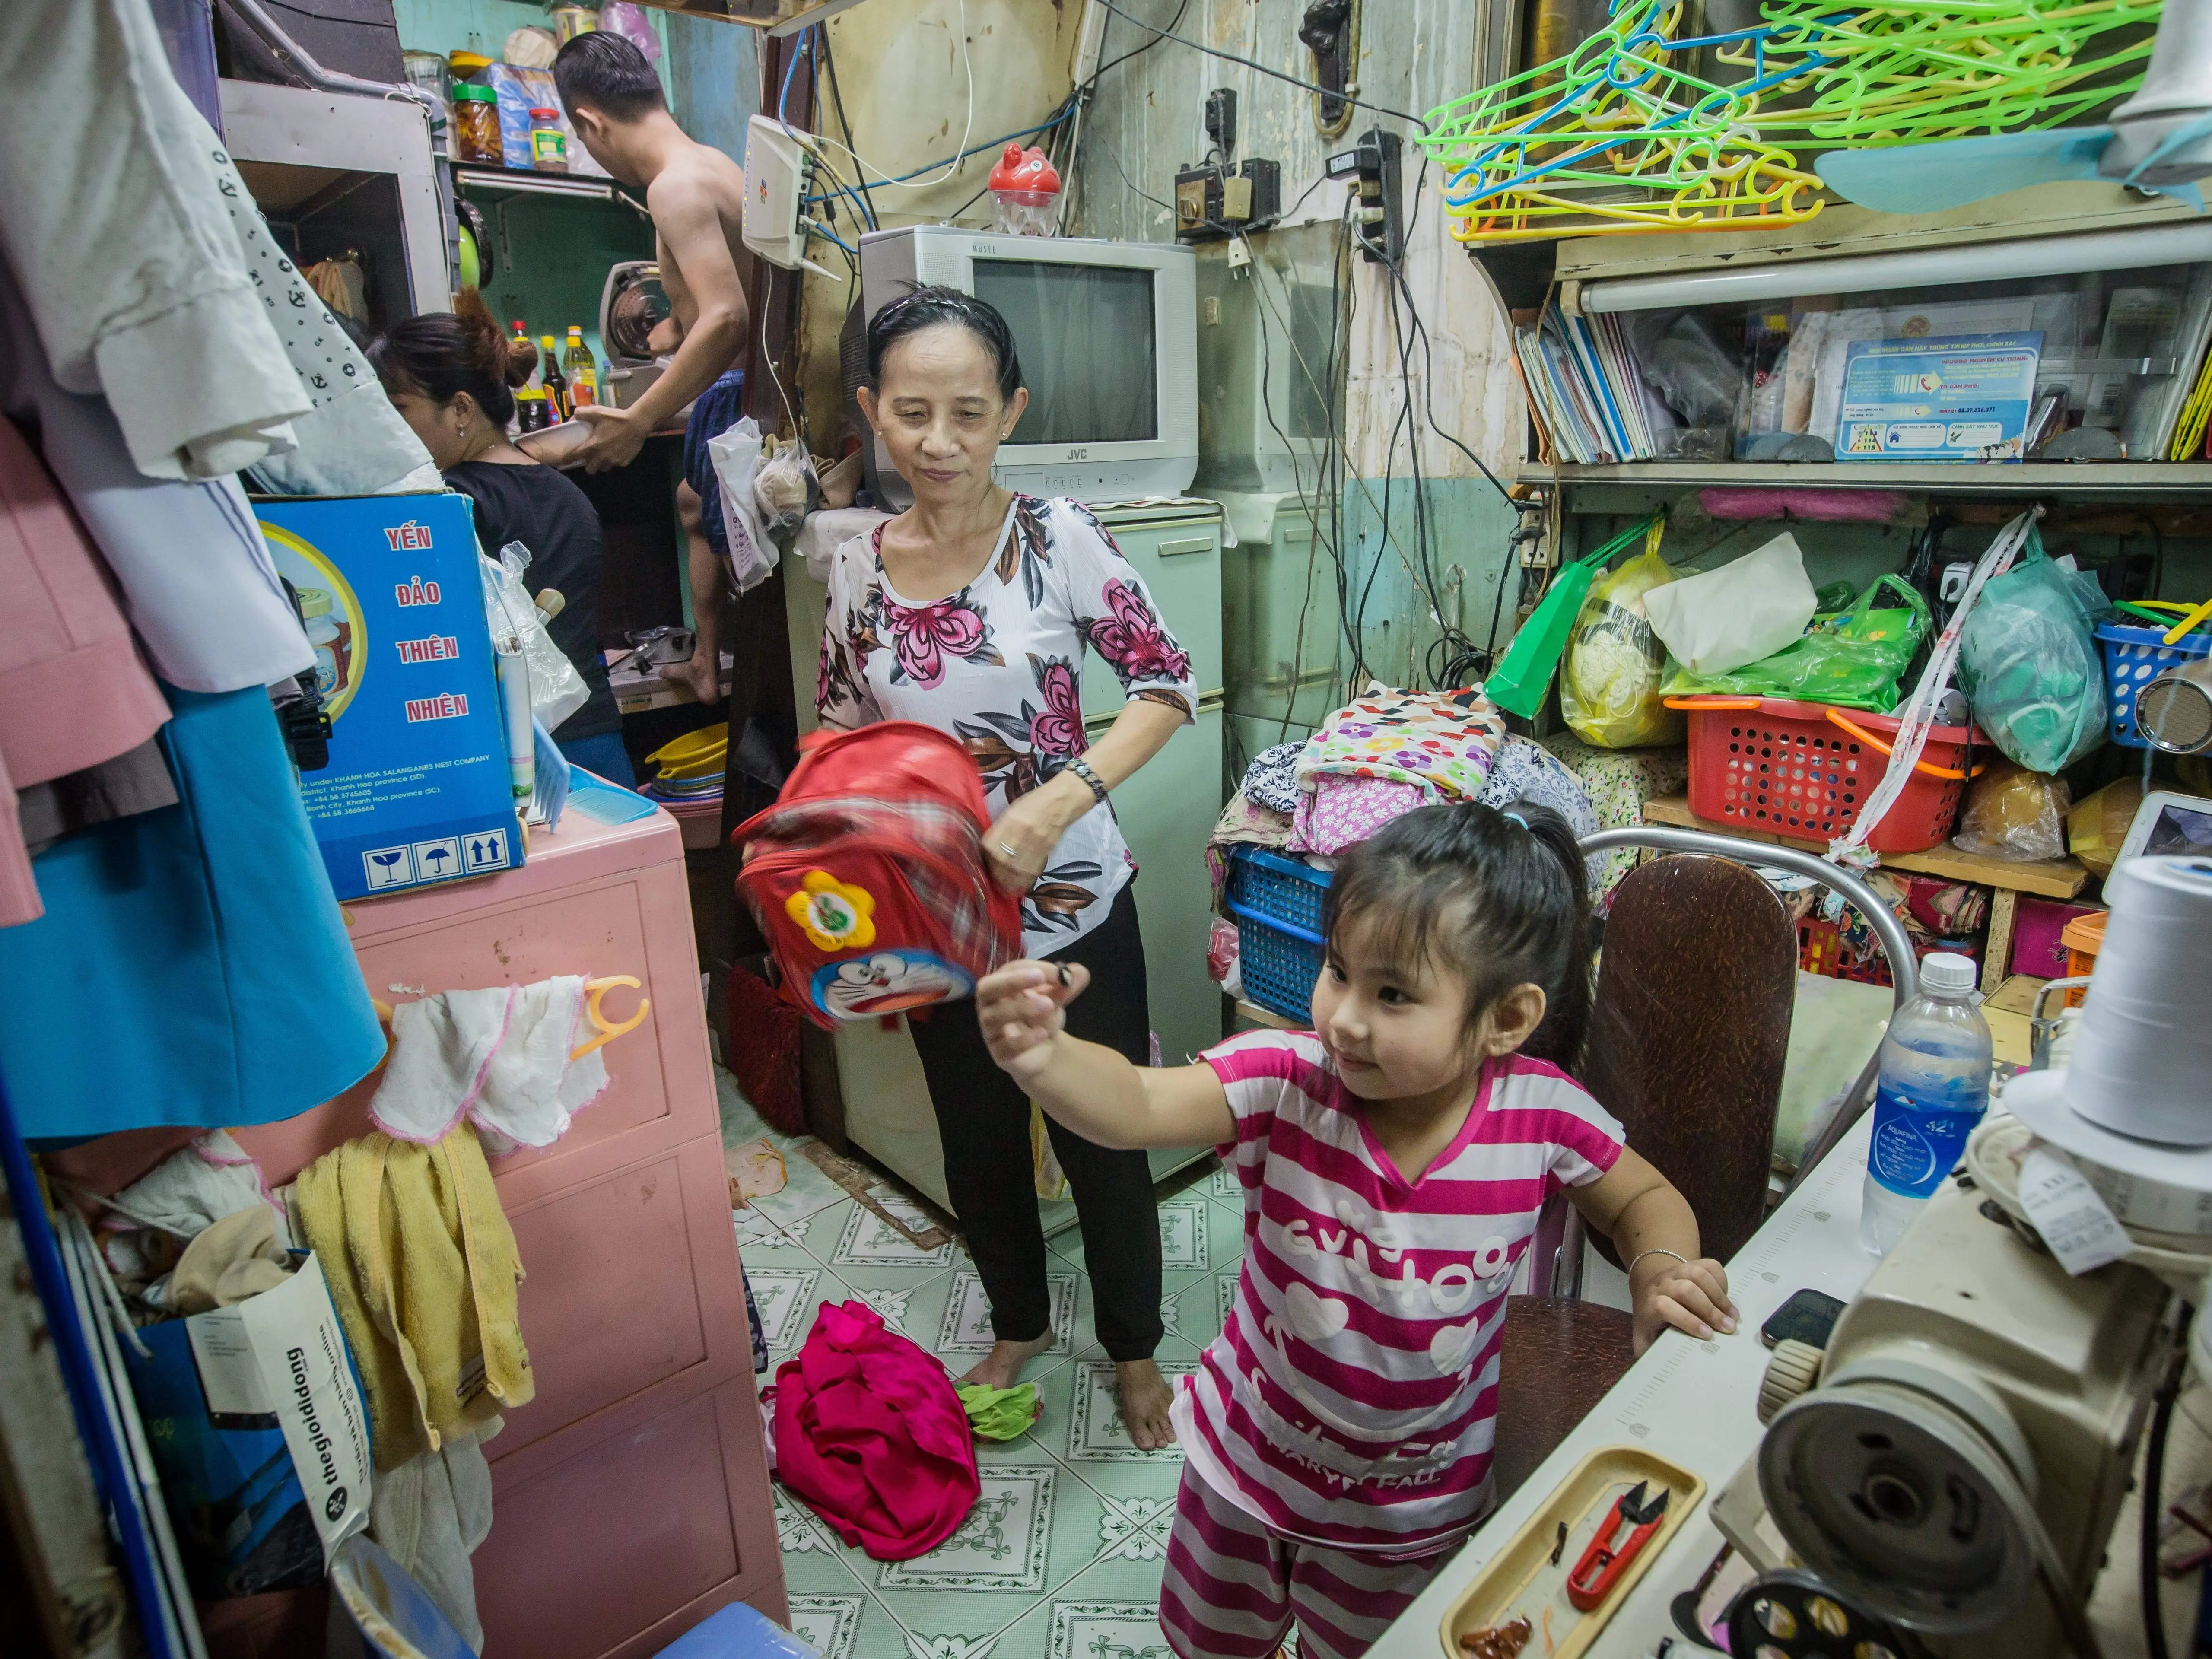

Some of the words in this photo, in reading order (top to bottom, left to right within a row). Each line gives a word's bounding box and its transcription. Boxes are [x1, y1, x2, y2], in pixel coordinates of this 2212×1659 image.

[1067, 449, 1087, 460] JVC
[384, 520, 432, 550] YẾN
[396, 576, 441, 607] ĐẢO
[396, 634, 459, 664] THIÊN
[405, 693, 469, 722] NHIÊN
[335, 774, 362, 783] KHANH
[364, 771, 381, 779] HOA
[383, 763, 433, 776] SALANGANES
[435, 761, 452, 769] NEST
[454, 754, 490, 766] COMPANY
[330, 784, 355, 792] Khanh
[375, 777, 408, 787] province
[346, 798, 371, 806] Khanh
[390, 790, 423, 801] province
[1887, 1125, 1918, 1142] AQUAFINA
[319, 1324, 334, 1364] online
[286, 1347, 338, 1484] thegioididong
